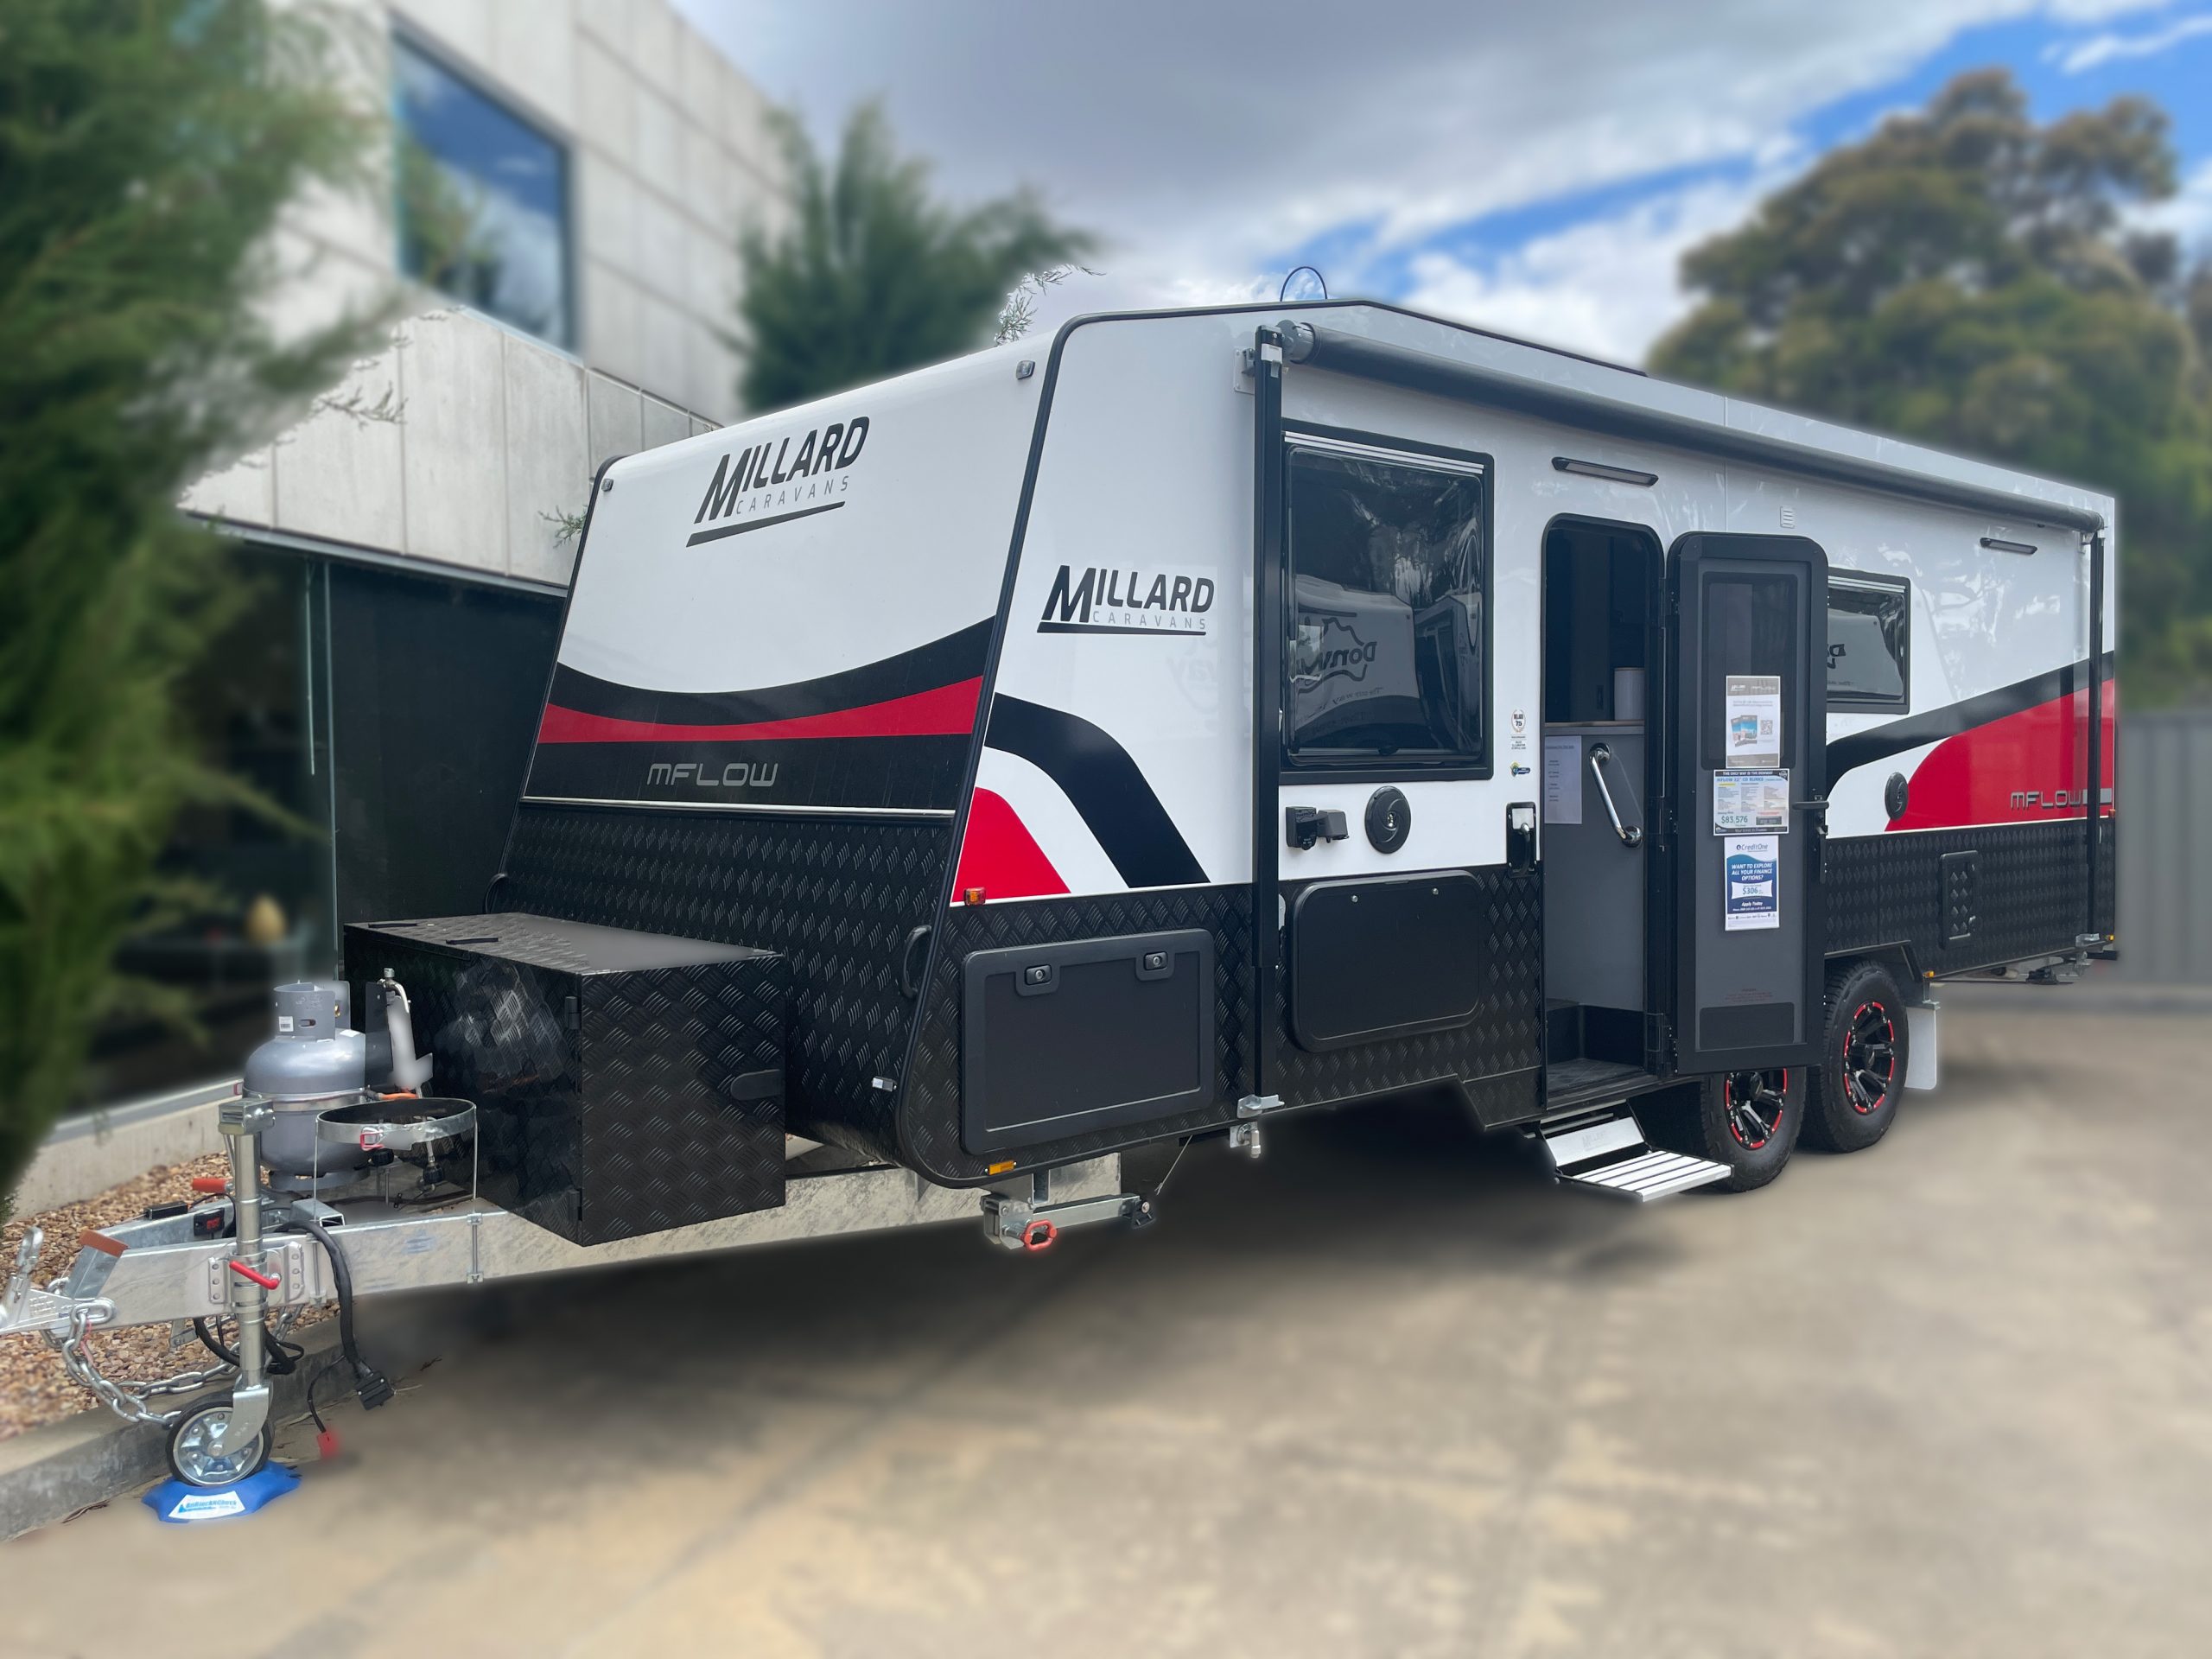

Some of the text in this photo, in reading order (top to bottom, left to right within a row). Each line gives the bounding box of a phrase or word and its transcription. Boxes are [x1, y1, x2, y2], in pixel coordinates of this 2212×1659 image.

[694, 416, 870, 524] MILLARD
[736, 475, 849, 515] CARAVANS
[1041, 564, 1215, 623] MILLARD
[1092, 610, 1206, 630] CARAVANS
[647, 763, 779, 787] MFLOW
[2011, 790, 2082, 809] MFLOW
[1721, 815, 1748, 824] $83,576
[1743, 887, 1758, 895] $306
